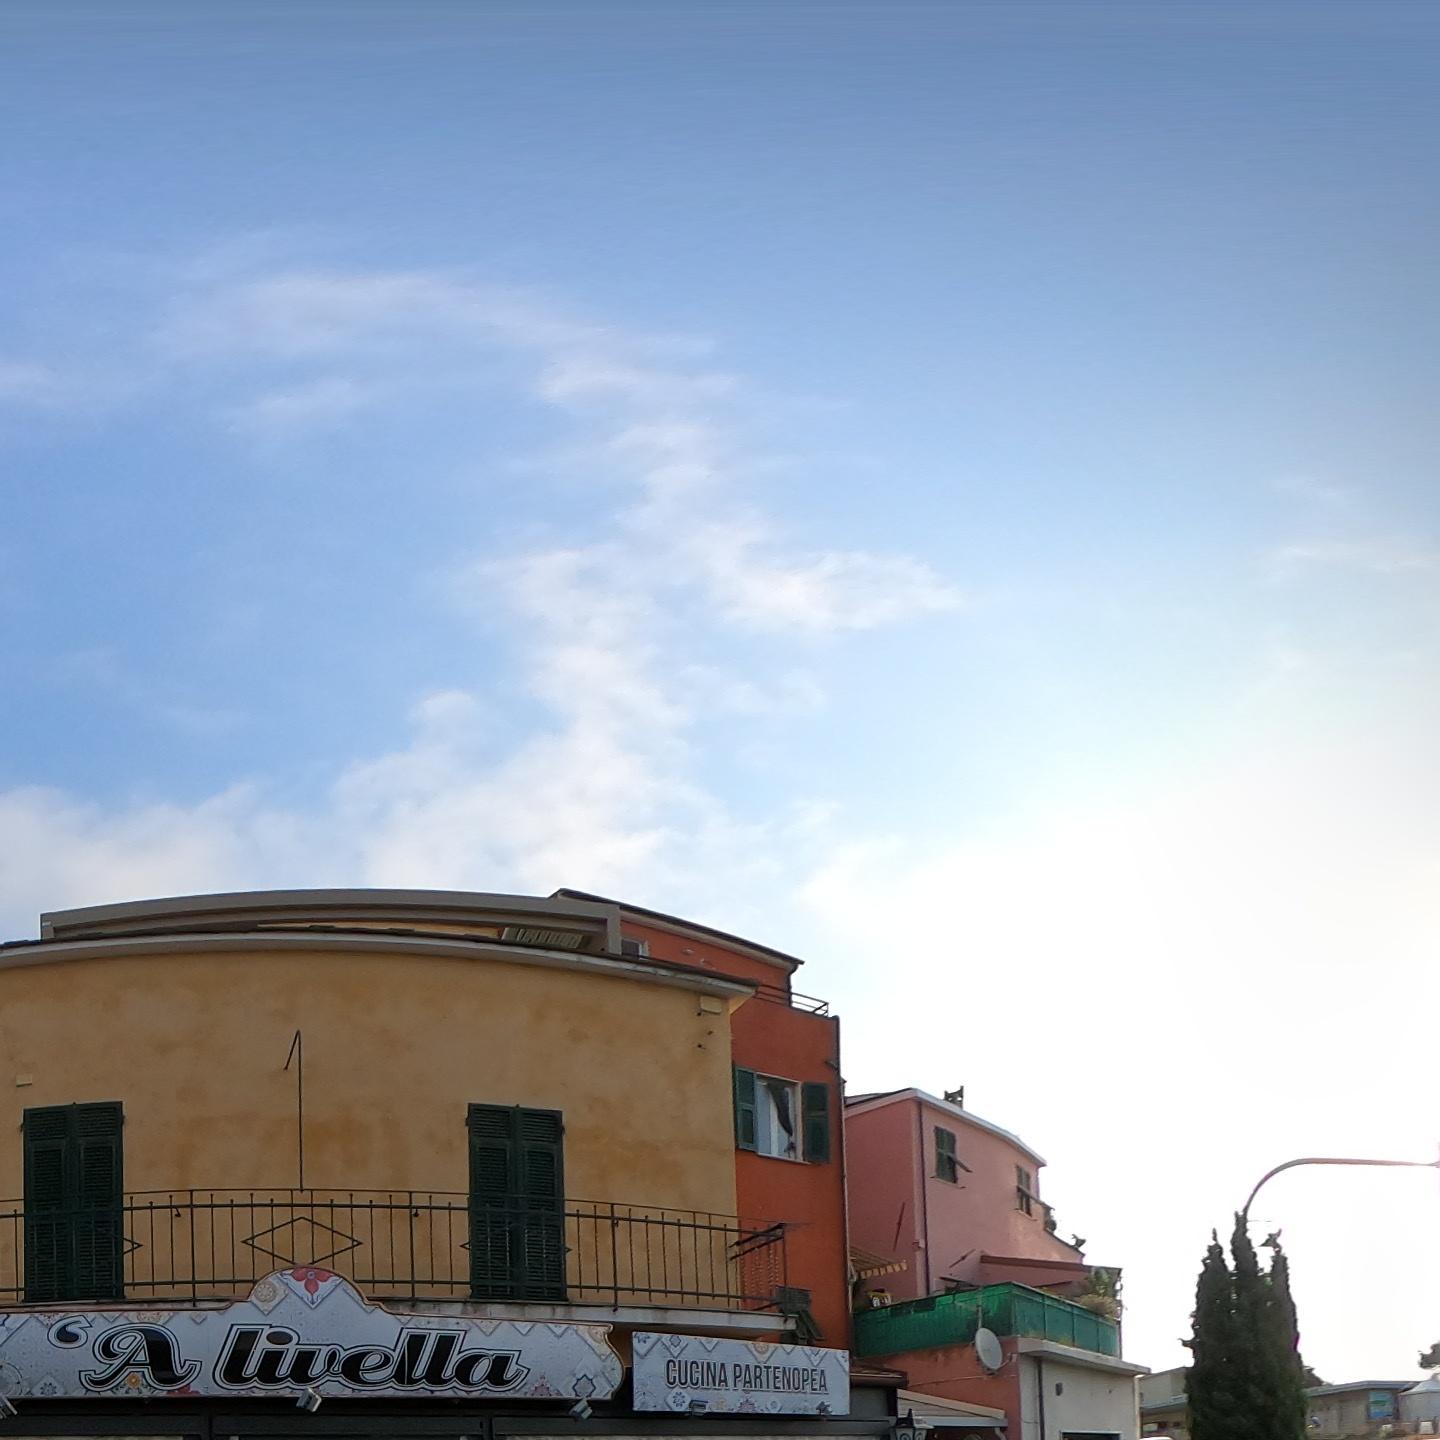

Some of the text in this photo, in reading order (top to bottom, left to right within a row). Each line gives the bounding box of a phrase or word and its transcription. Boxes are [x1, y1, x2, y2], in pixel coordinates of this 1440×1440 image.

[211, 1323, 531, 1393] livella
[666, 1358, 827, 1392] CUCINA PARTENOPEA
